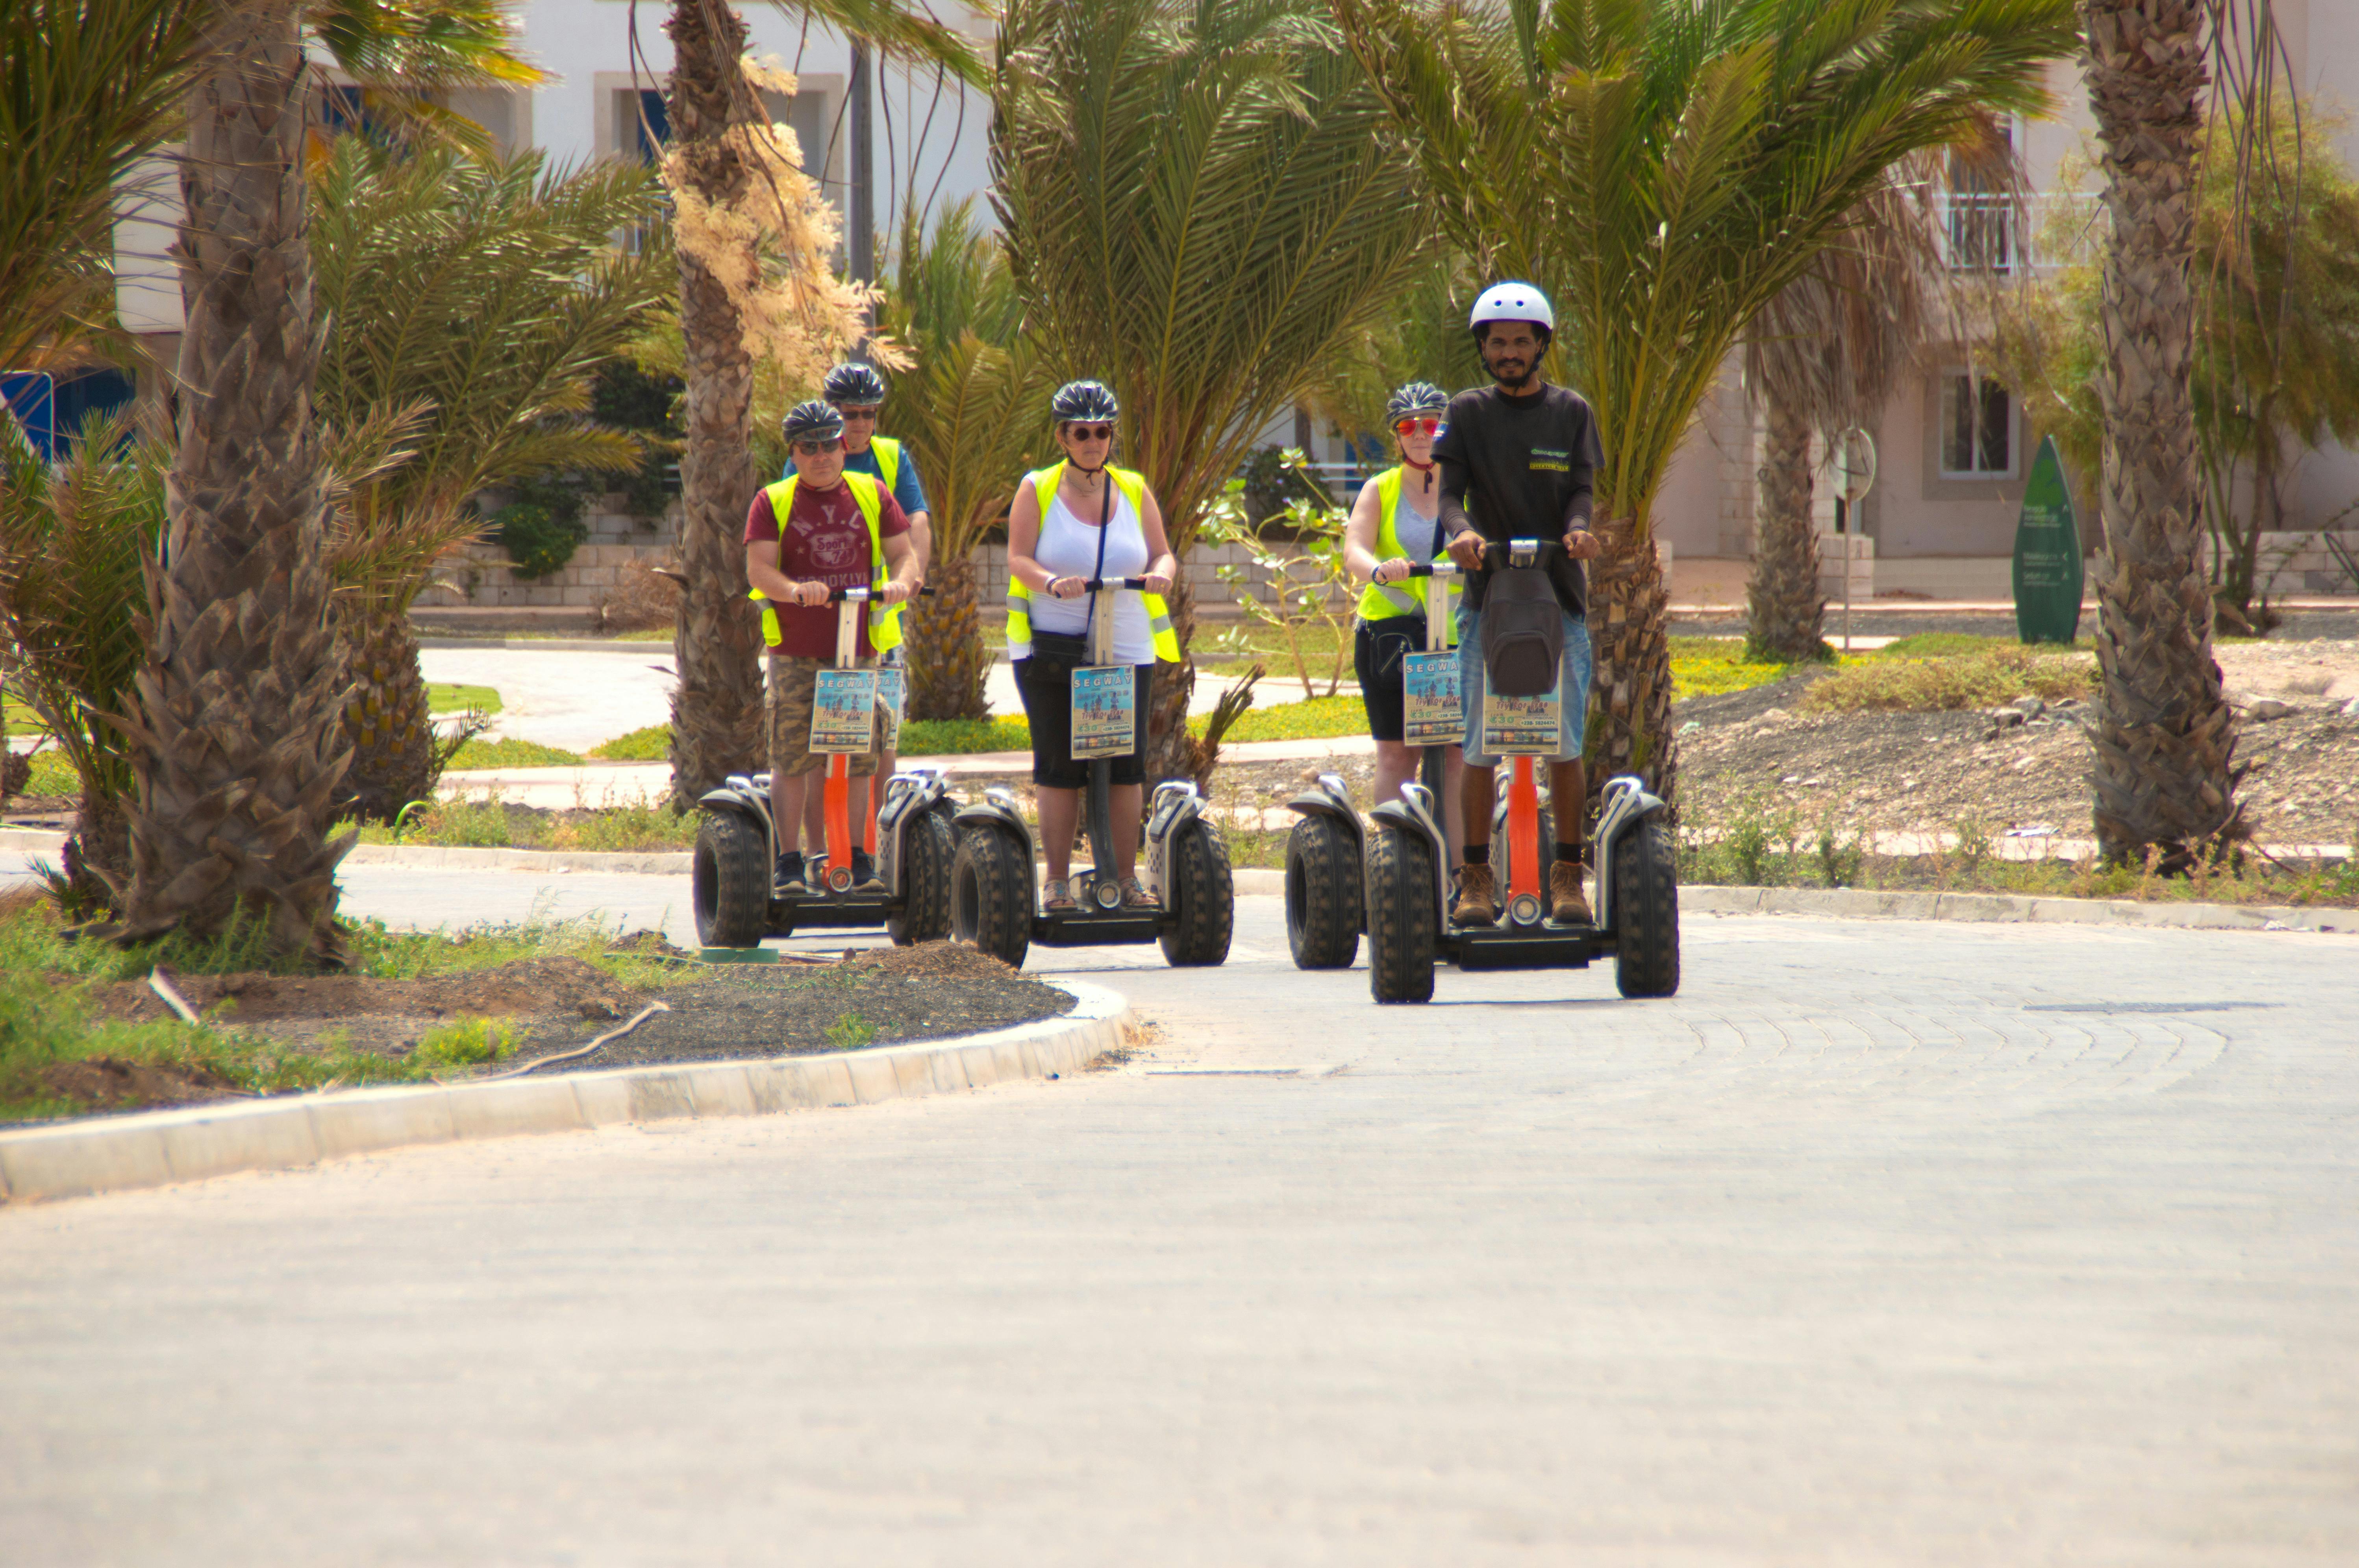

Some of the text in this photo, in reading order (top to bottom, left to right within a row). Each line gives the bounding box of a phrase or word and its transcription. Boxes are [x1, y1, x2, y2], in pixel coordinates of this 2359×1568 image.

[1406, 661, 1458, 673] SEGWA
[818, 679, 874, 688] SEGWAY
[1074, 675, 1132, 688] SEGWAY
[1415, 698, 1427, 706] Try
[1496, 700, 1548, 711] Try for free
